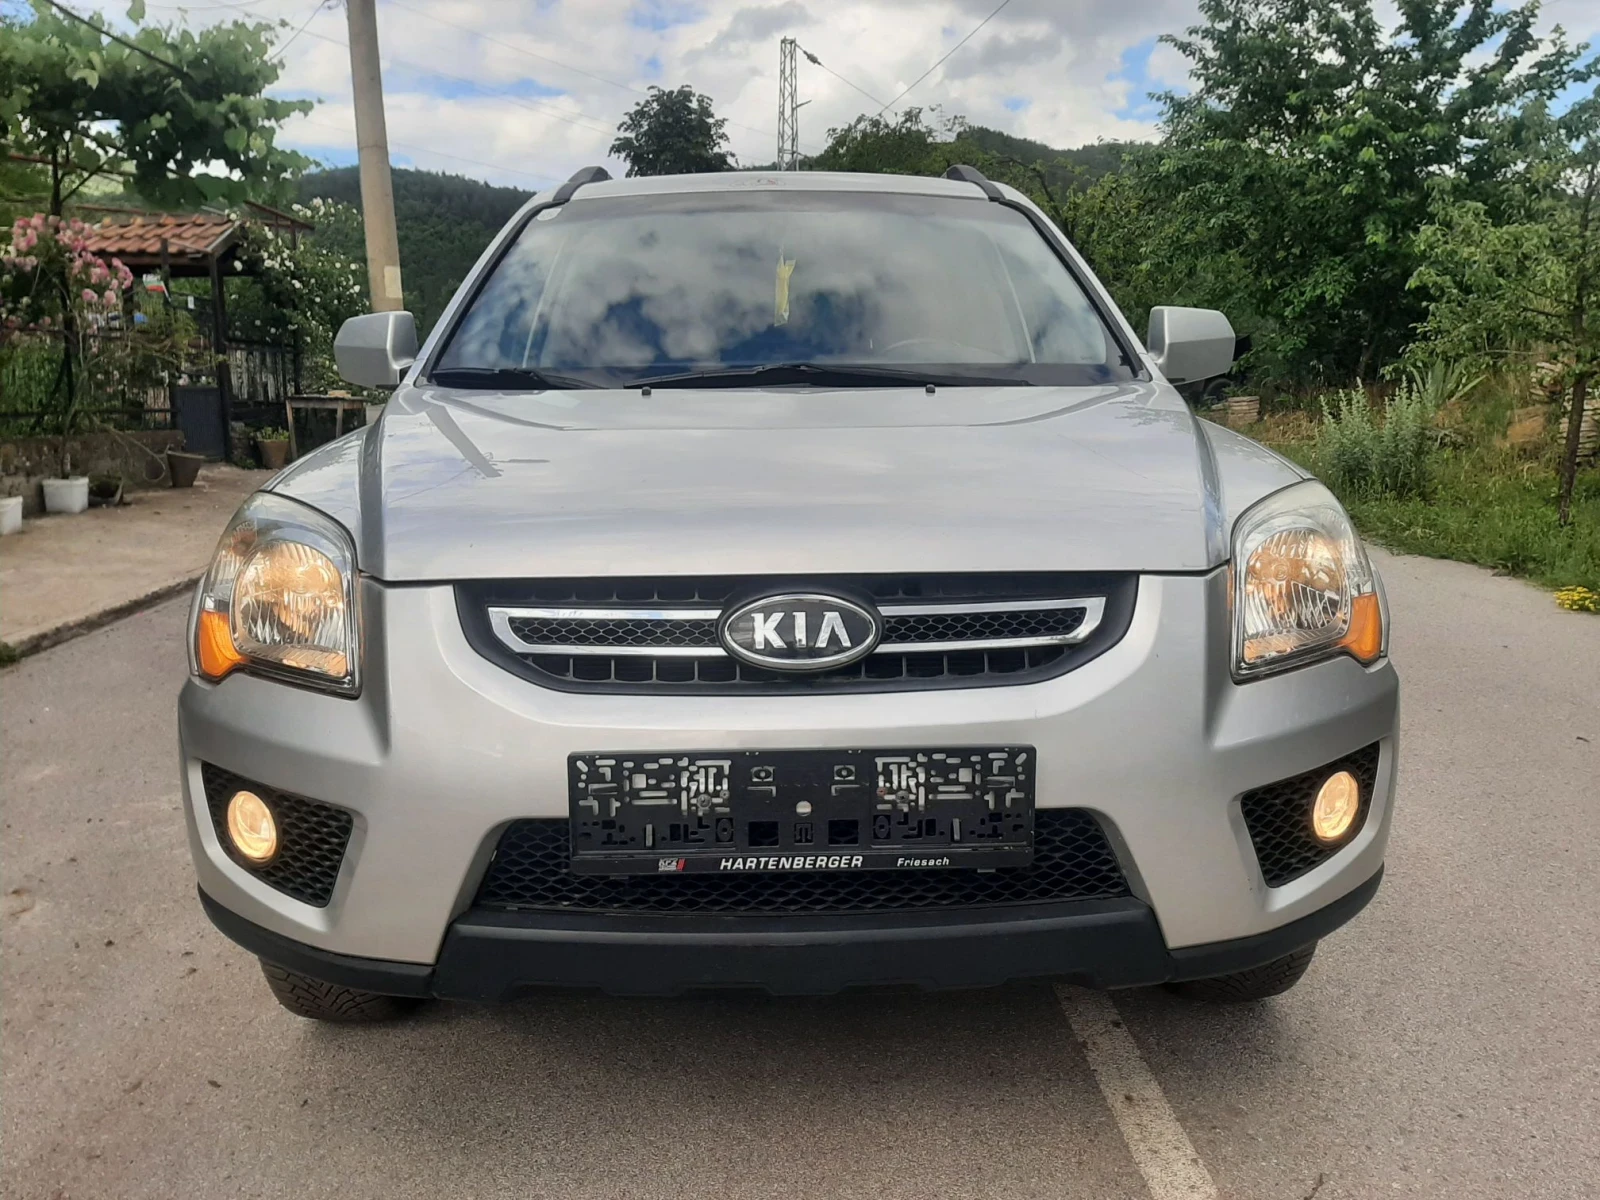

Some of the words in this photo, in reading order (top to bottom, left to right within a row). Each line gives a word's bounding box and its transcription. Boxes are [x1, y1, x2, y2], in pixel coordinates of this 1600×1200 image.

[751, 611, 852, 649] KIA
[720, 856, 863, 870] HARTENBERGER
[896, 857, 950, 867] Friesach
